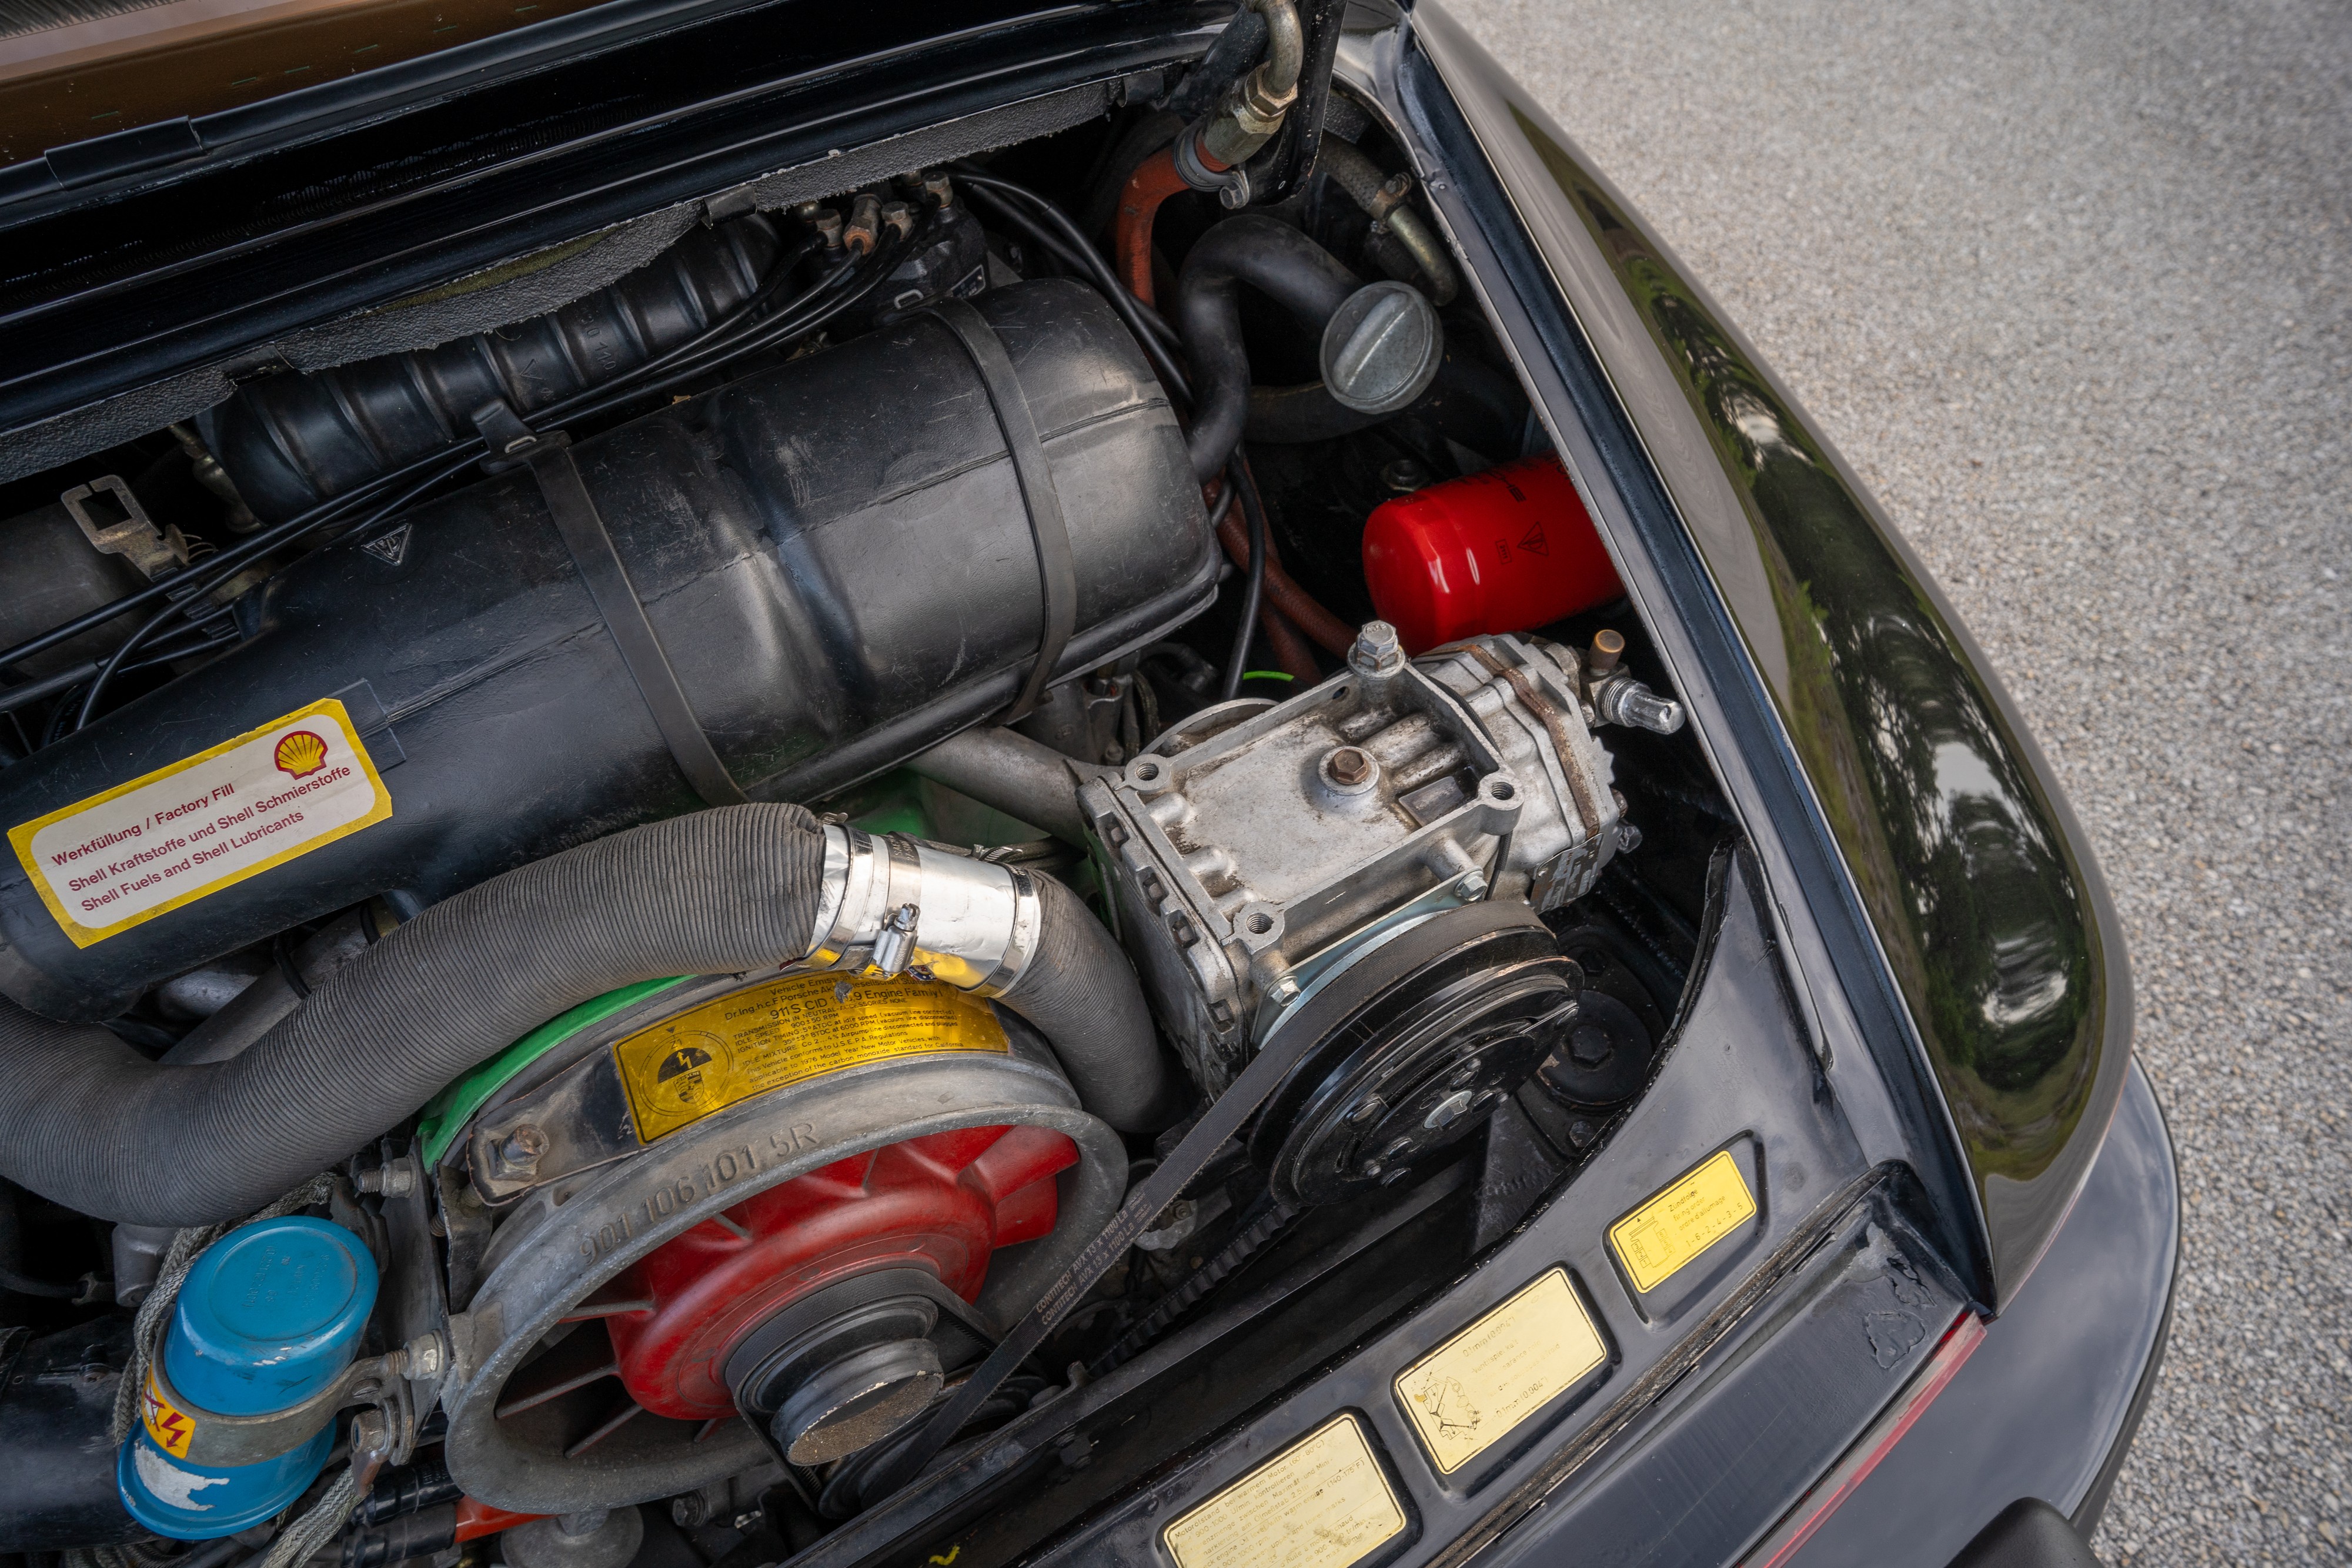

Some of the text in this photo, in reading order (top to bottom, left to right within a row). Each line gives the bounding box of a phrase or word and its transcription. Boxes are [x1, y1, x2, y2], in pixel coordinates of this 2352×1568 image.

[51, 783, 235, 868] Werkfüllung / Factory Fill
[68, 763, 352, 893] Shell Kraftstoffe und Shell Schmierstoffe
[80, 809, 305, 912] Shell Fuels and Shell Lubricants
[770, 981, 806, 996] Vehicle
[780, 987, 819, 1004] Porsche
[804, 996, 828, 1011] CID
[866, 988, 903, 1000] Engine
[733, 1017, 790, 1040] TRANSMISSION
[890, 997, 907, 1005] NONE
[734, 1036, 751, 1046] IDLE
[823, 1012, 839, 1021] RPM
[737, 1037, 771, 1053] IGNITION
[857, 1013, 877, 1022] speed
[810, 1028, 830, 1038] BTDC
[840, 1021, 858, 1031] 6000
[860, 1018, 876, 1027] RPM
[742, 1056, 760, 1066] IDLE
[841, 1028, 869, 1038] Airpump
[883, 1021, 923, 1031] disconnected
[936, 1019, 957, 1028] plugged
[761, 1056, 787, 1069] Vehicle
[789, 1045, 823, 1061] conforms
[868, 1029, 907, 1041] Regulations
[748, 1065, 788, 1084] applicable
[800, 1056, 817, 1065] 1976
[820, 1050, 840, 1060] Model
[844, 1046, 858, 1054] Year
[860, 1042, 876, 1051] New
[751, 1081, 764, 1090] the
[766, 1068, 803, 1085] exception
[828, 1055, 854, 1066] carbon
[857, 1047, 890, 1058] monoxide
[894, 1044, 922, 1052] standard
[575, 1213, 637, 1265] 901
[639, 1174, 699, 1223] 106
[699, 1145, 758, 1191] 101
[1667, 1188, 1699, 1212] Zündfolge
[1689, 1196, 1706, 1210] order
[1678, 1216, 1695, 1231] ordre
[1034, 1271, 1074, 1313] CONTITECH
[1070, 1254, 1088, 1273] AVX
[1085, 1243, 1098, 1256] 13
[1101, 1219, 1120, 1239] 1100
[1040, 1281, 1080, 1326] CONTITECH
[1075, 1265, 1095, 1285] AVX
[1091, 1255, 1104, 1268] 13
[1107, 1231, 1127, 1252] 1100
[1121, 1221, 1136, 1236] La
[1253, 1471, 1295, 1499] kontrollieren
[1174, 1507, 1220, 1539] Motorölstand
[1237, 1479, 1265, 1499] warmem
[1215, 1544, 1238, 1562] engine
[1283, 1501, 1302, 1516] warm
[1302, 1487, 1324, 1504] engine
[1238, 1499, 1269, 1520] zwischen
[1240, 1521, 1252, 1530] am
